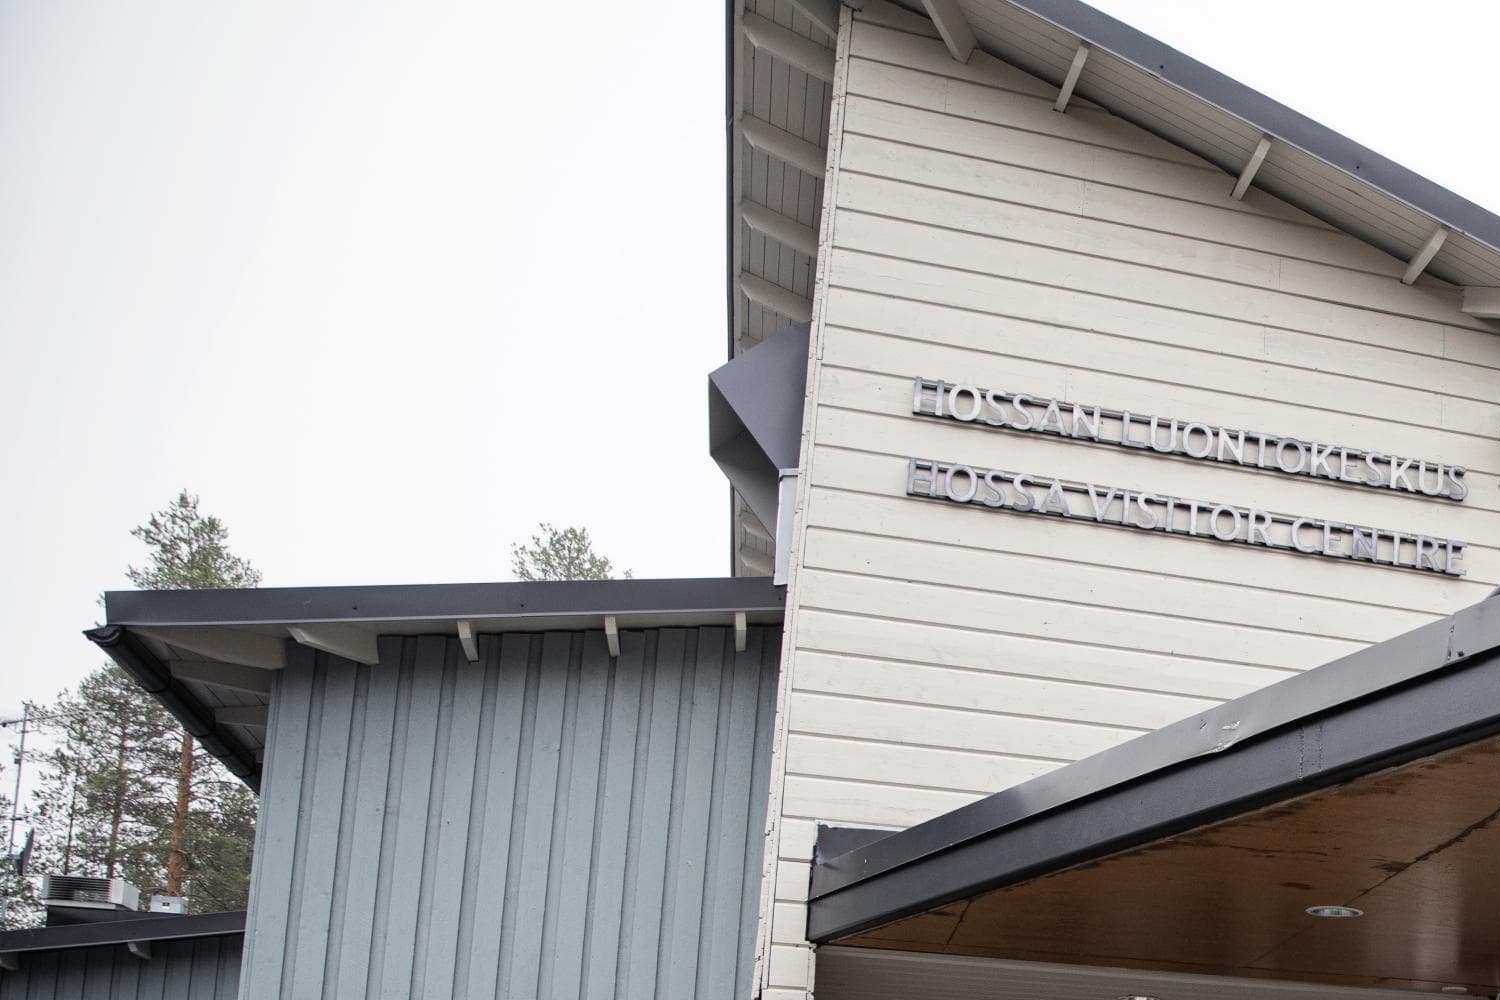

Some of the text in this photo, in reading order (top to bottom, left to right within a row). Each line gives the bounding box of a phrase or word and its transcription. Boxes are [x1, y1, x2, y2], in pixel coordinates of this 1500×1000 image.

[912, 376, 1470, 502] HOSSAN LUONTOKESKUS
[906, 457, 1468, 577] HOSSA VISITOR CENTRE
